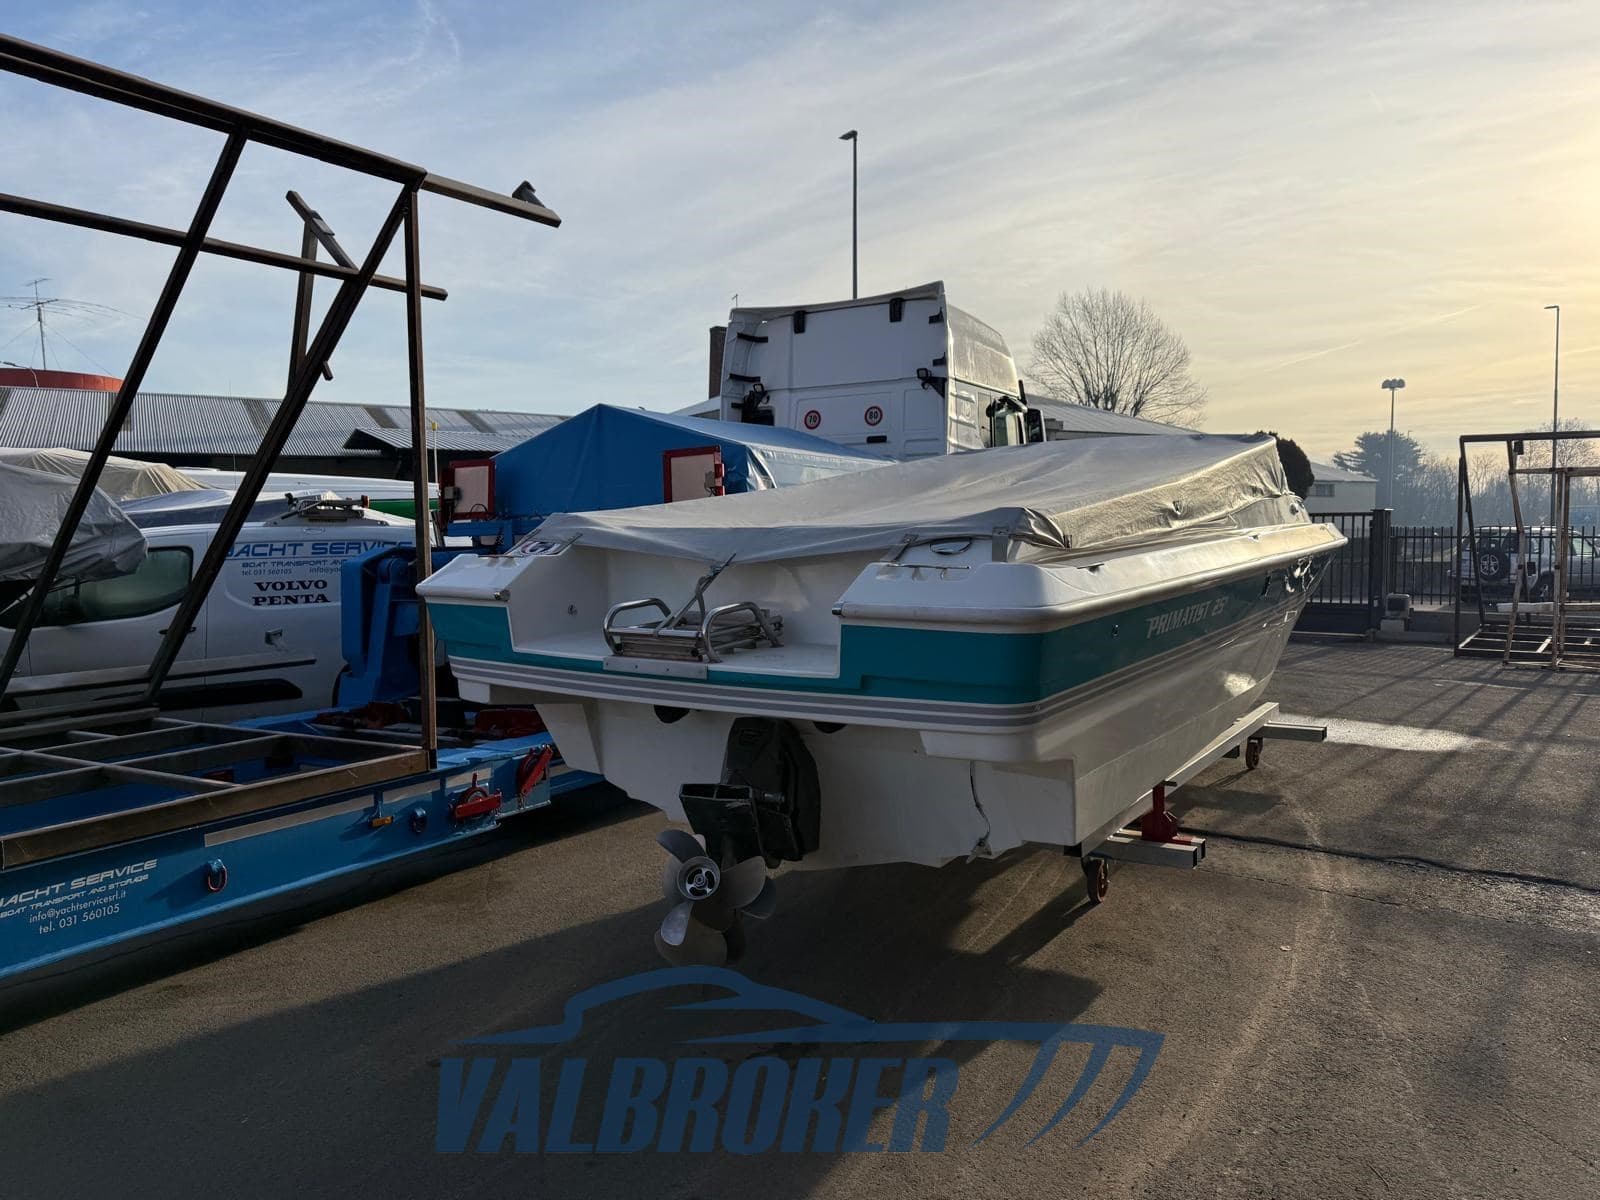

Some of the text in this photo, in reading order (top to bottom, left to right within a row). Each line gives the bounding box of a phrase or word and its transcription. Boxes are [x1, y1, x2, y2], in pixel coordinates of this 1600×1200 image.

[271, 559, 328, 568] TRANSPORT
[252, 593, 330, 606] PENTA
[254, 579, 328, 592] VOLVO
[1145, 601, 1211, 639] PRIMATIST
[70, 859, 157, 890] SERVICE
[29, 890, 126, 923] info@yachtservicesrl.it
[30, 890, 87, 910] TRANSPORT
[88, 886, 106, 894] AND
[108, 874, 149, 889] STORAGE
[39, 903, 120, 934] tel. 031 560105
